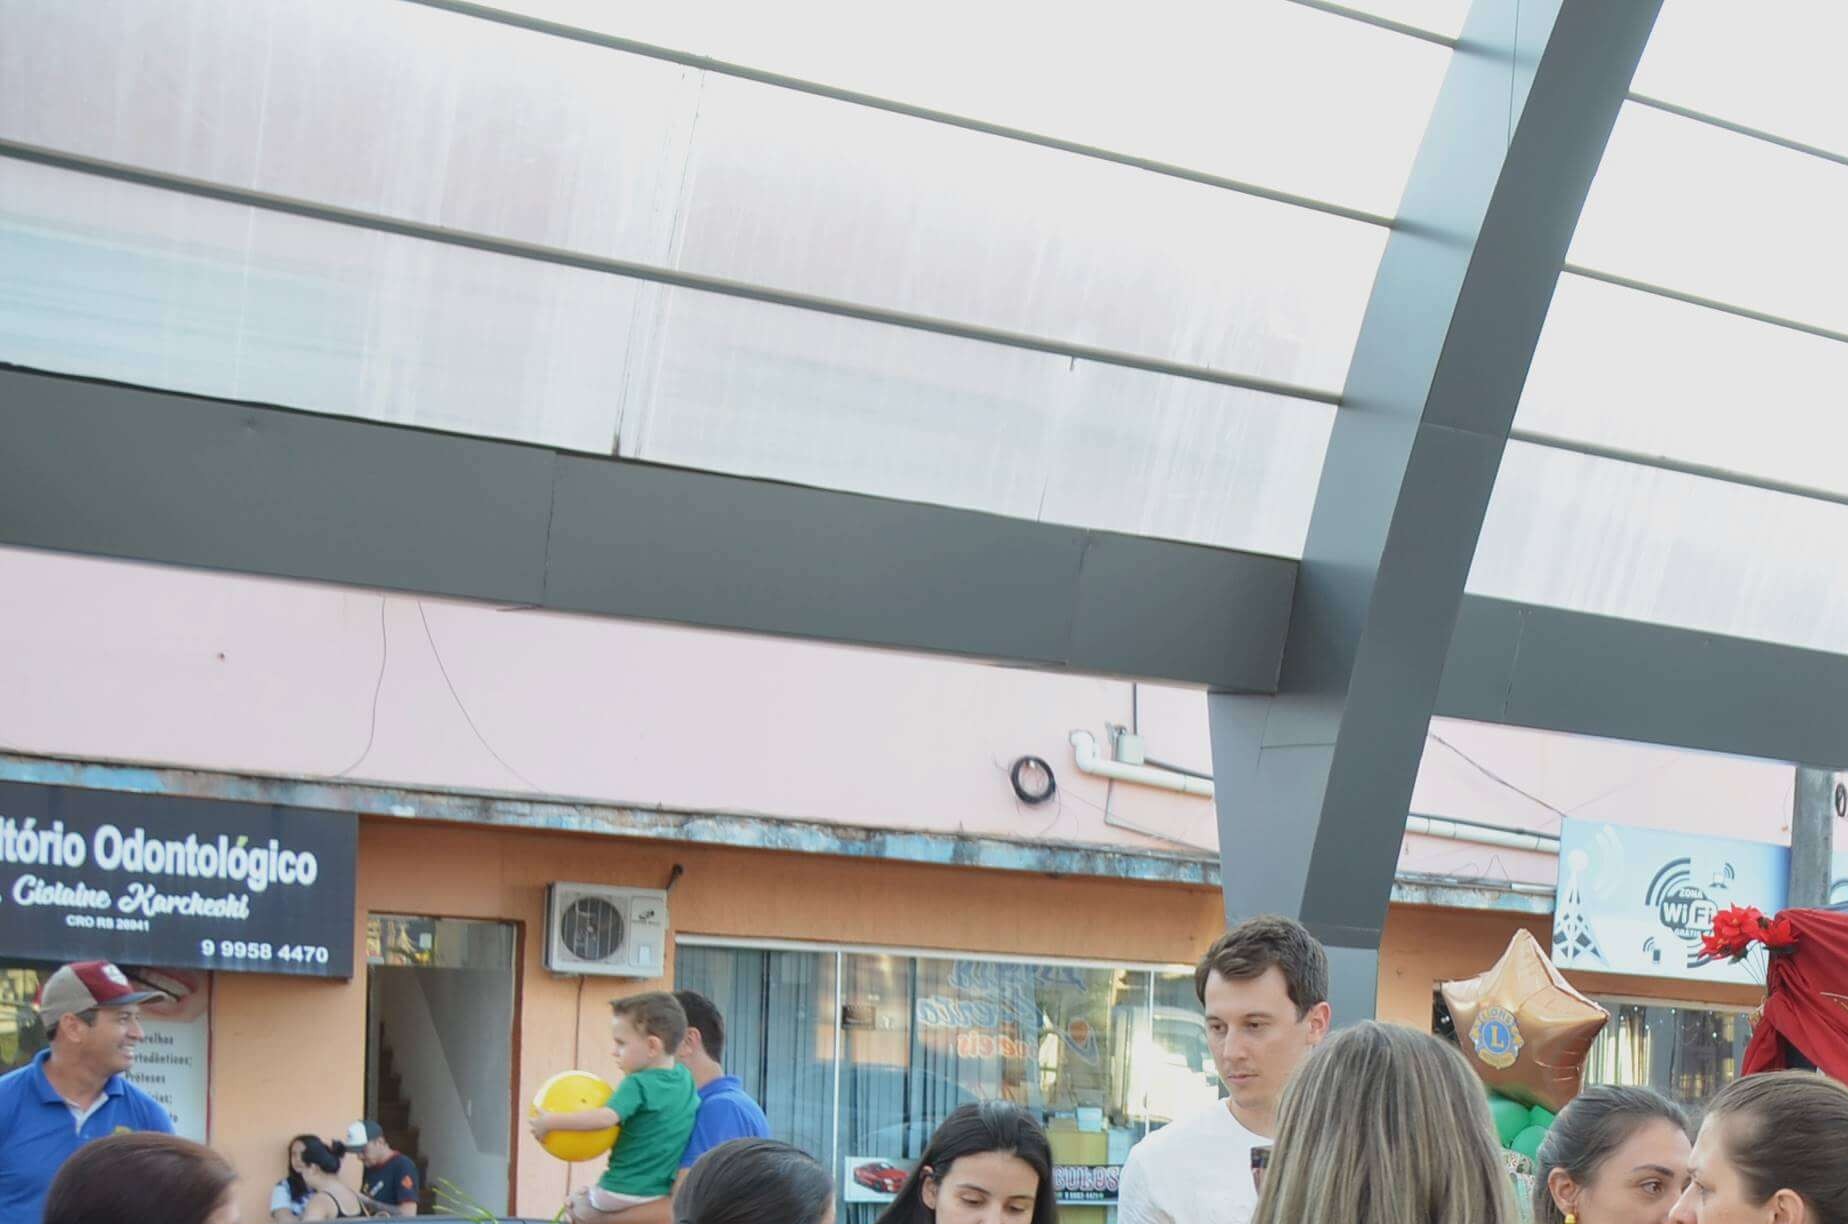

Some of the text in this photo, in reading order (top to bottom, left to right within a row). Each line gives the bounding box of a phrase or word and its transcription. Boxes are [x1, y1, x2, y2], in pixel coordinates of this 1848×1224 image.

[94, 824, 318, 892] Odontológico
[66, 915, 94, 929] CRO
[201, 939, 329, 964] 9 9958 4470
[1490, 1025, 1505, 1049] L
